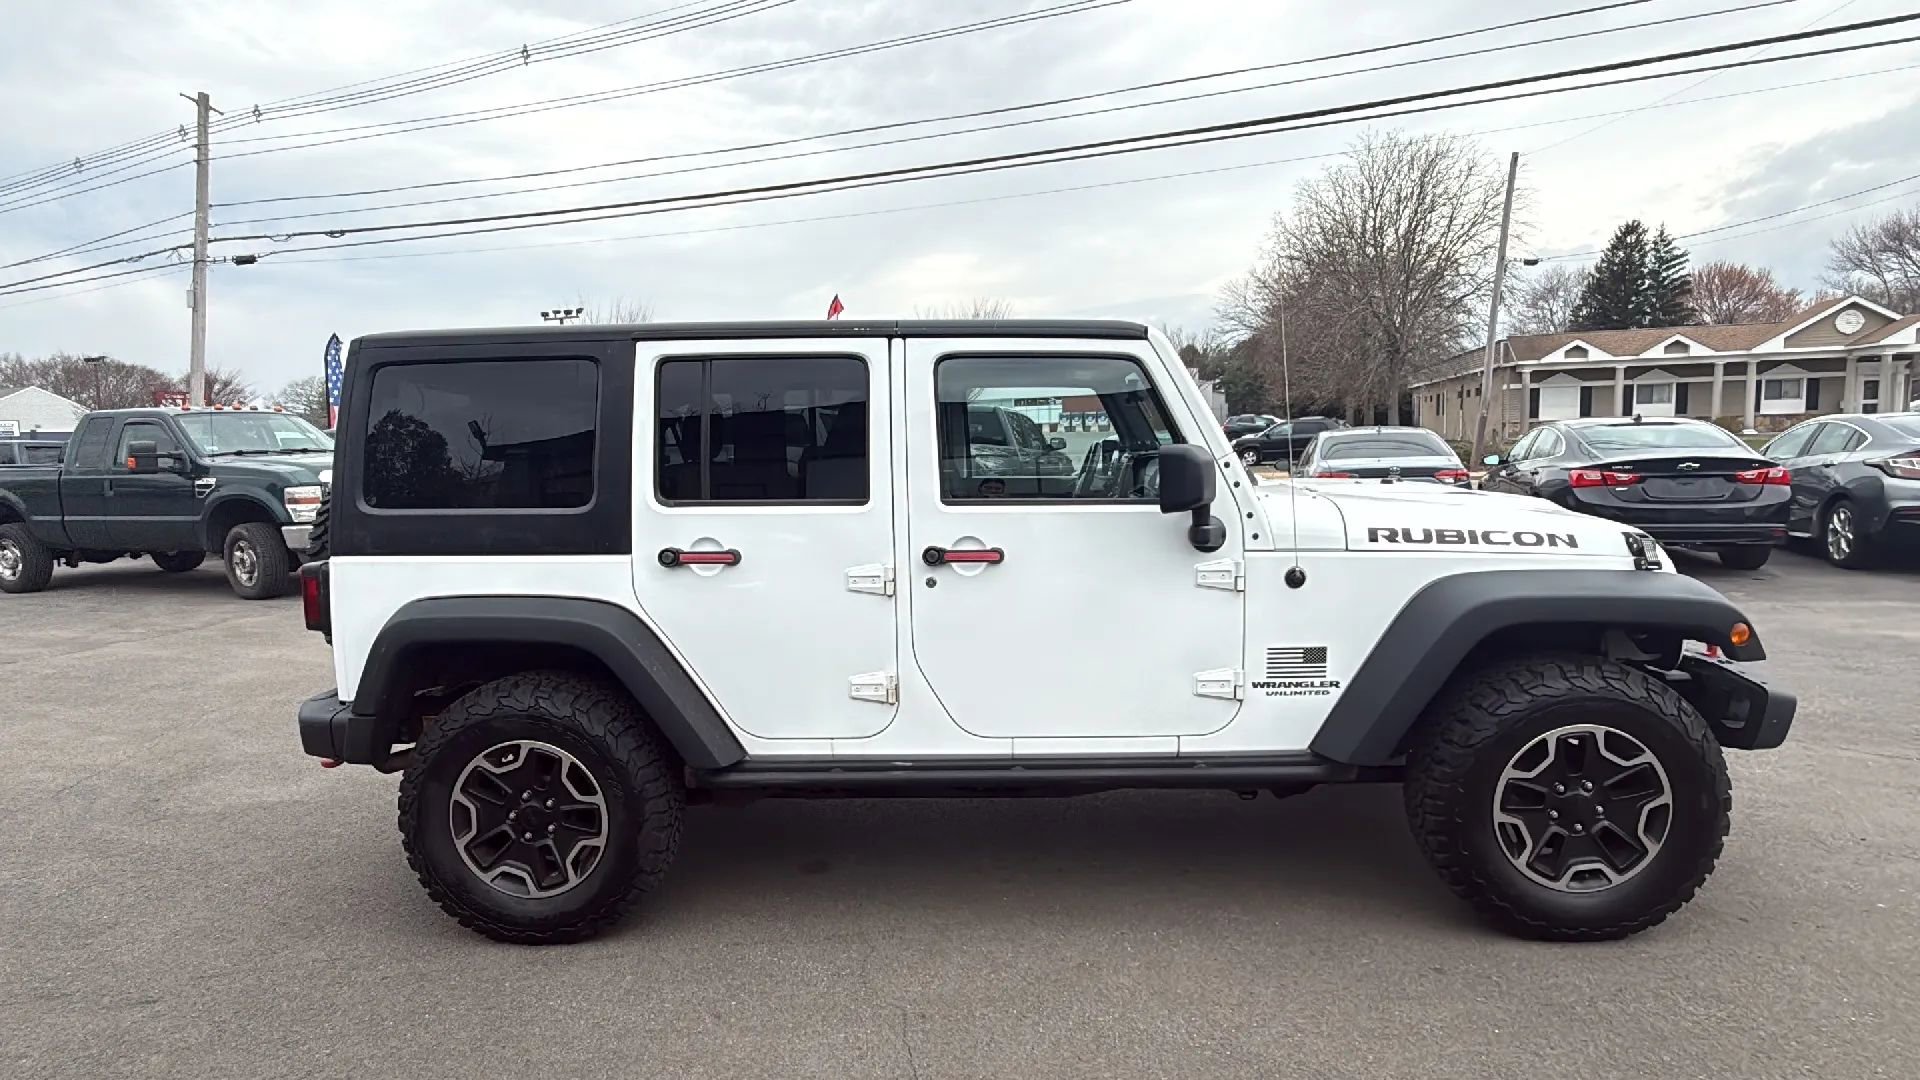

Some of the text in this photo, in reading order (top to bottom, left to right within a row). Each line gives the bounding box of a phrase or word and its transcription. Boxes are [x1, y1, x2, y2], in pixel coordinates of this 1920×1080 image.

[1367, 527, 1579, 549] RUBICON
[1251, 680, 1341, 689] WRANGLER
[1265, 689, 1331, 697] UNLIMITED
